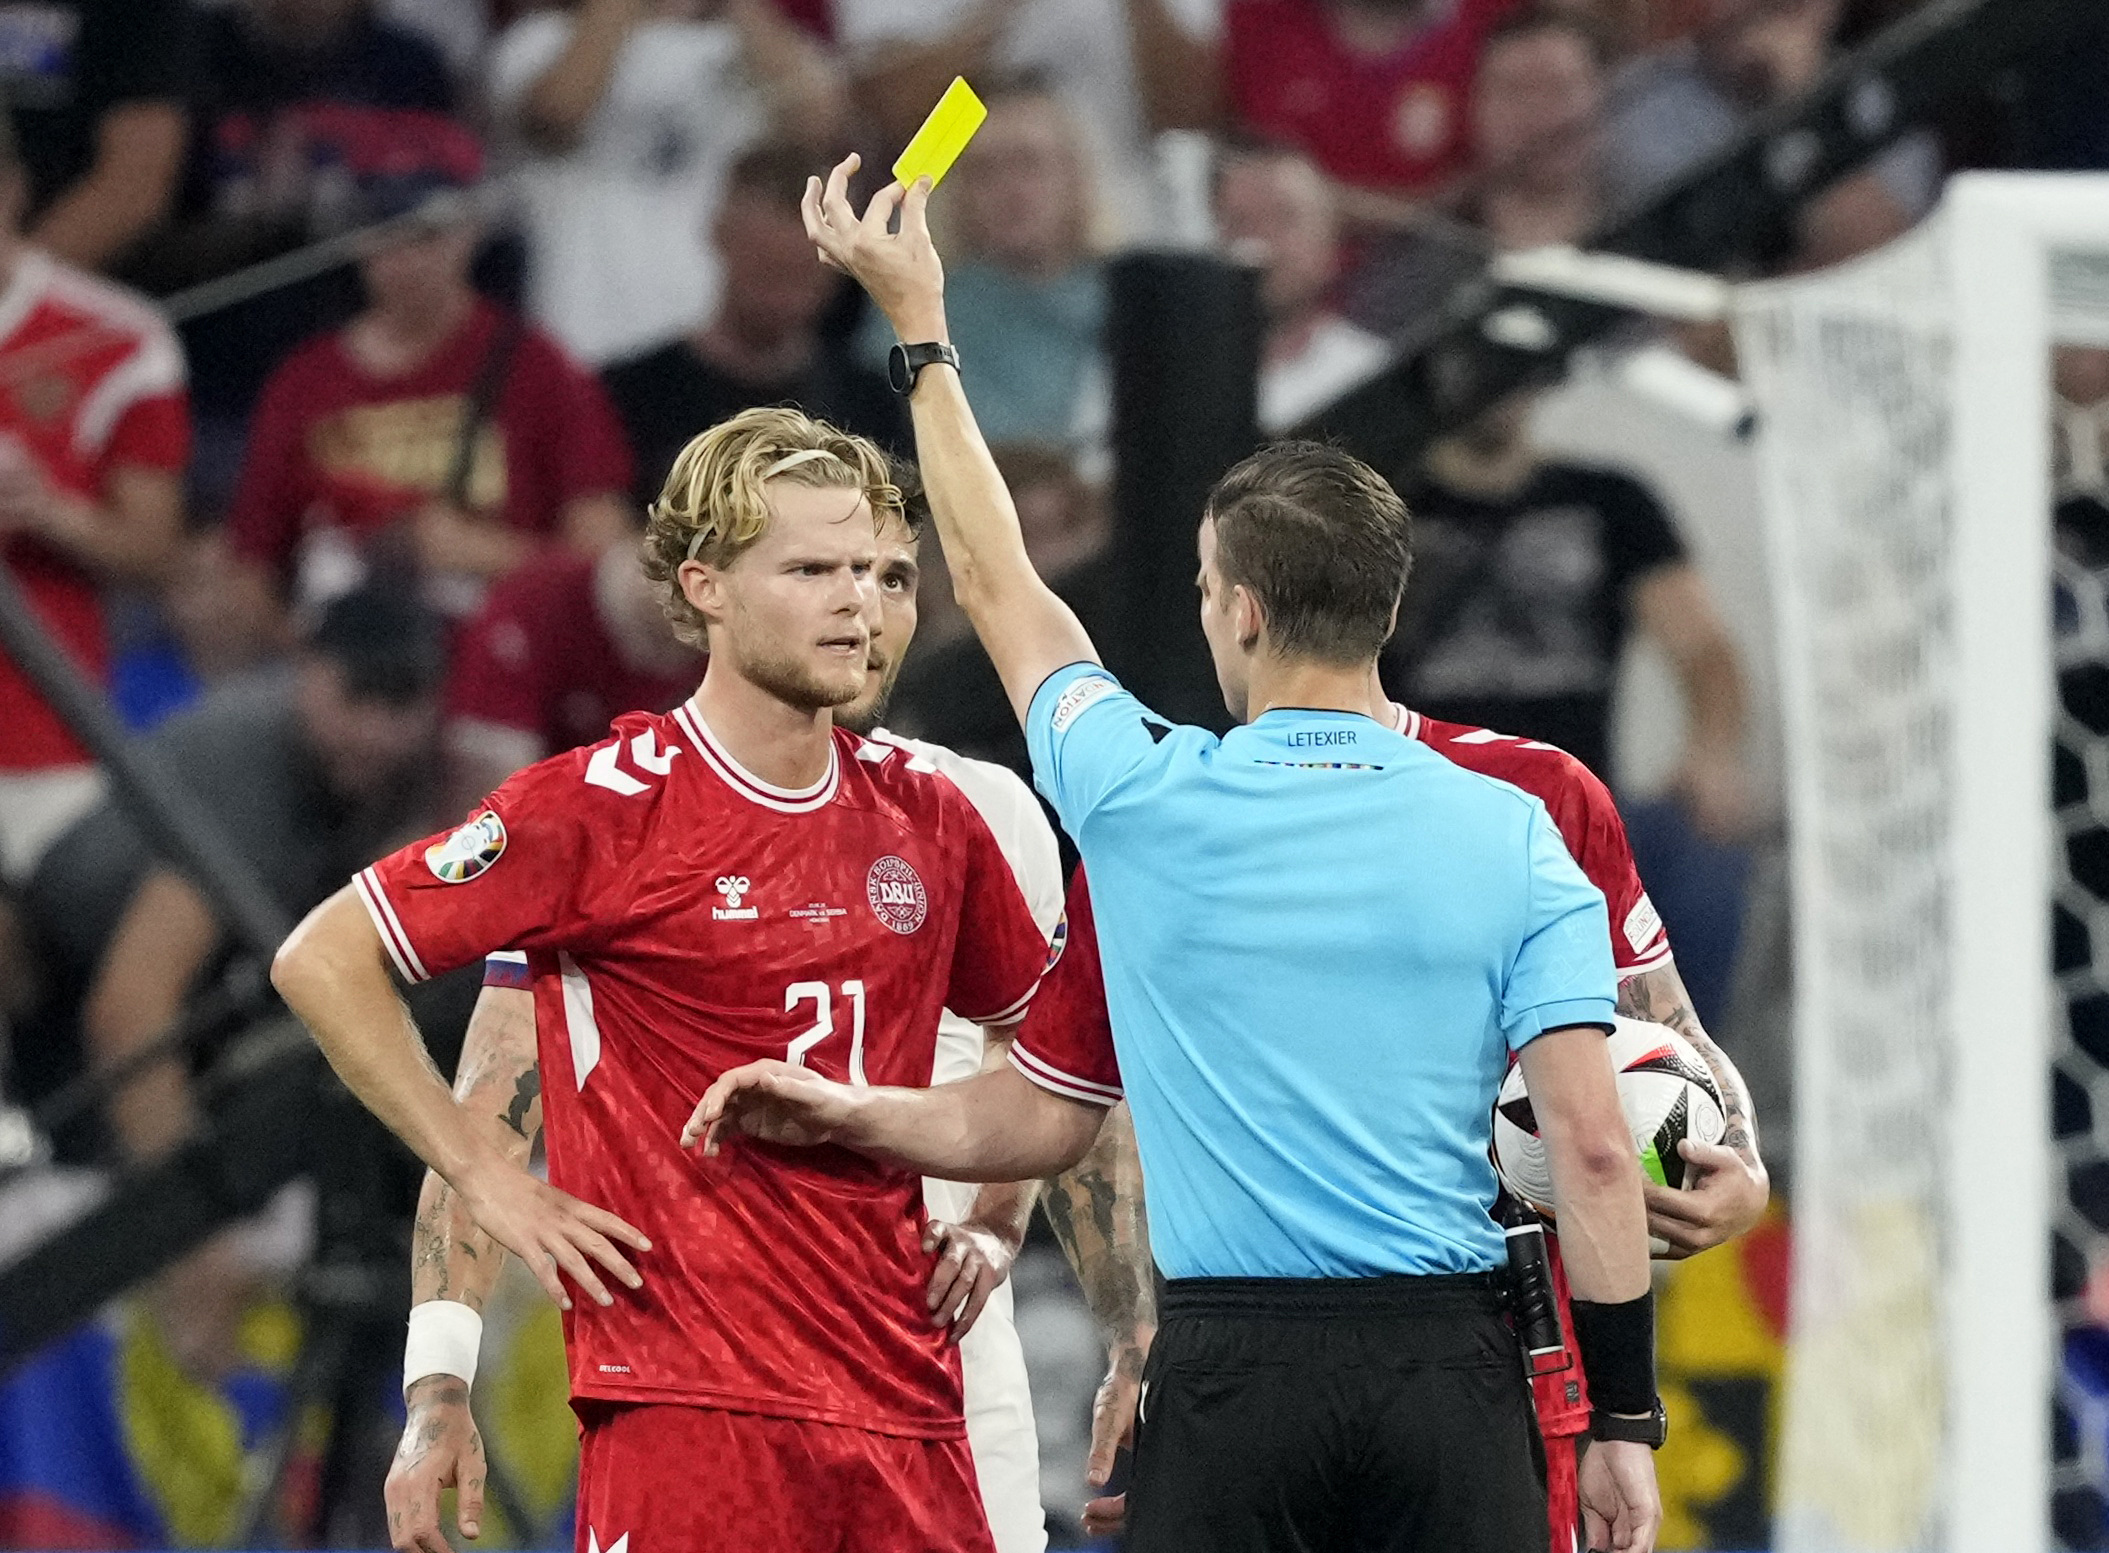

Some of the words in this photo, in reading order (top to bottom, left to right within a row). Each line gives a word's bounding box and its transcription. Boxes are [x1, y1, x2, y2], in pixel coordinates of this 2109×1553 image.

[1287, 731, 1357, 747] LETEXIER
[880, 881, 916, 904] DBU
[712, 905, 759, 920] hummel
[785, 980, 868, 1087] 21
